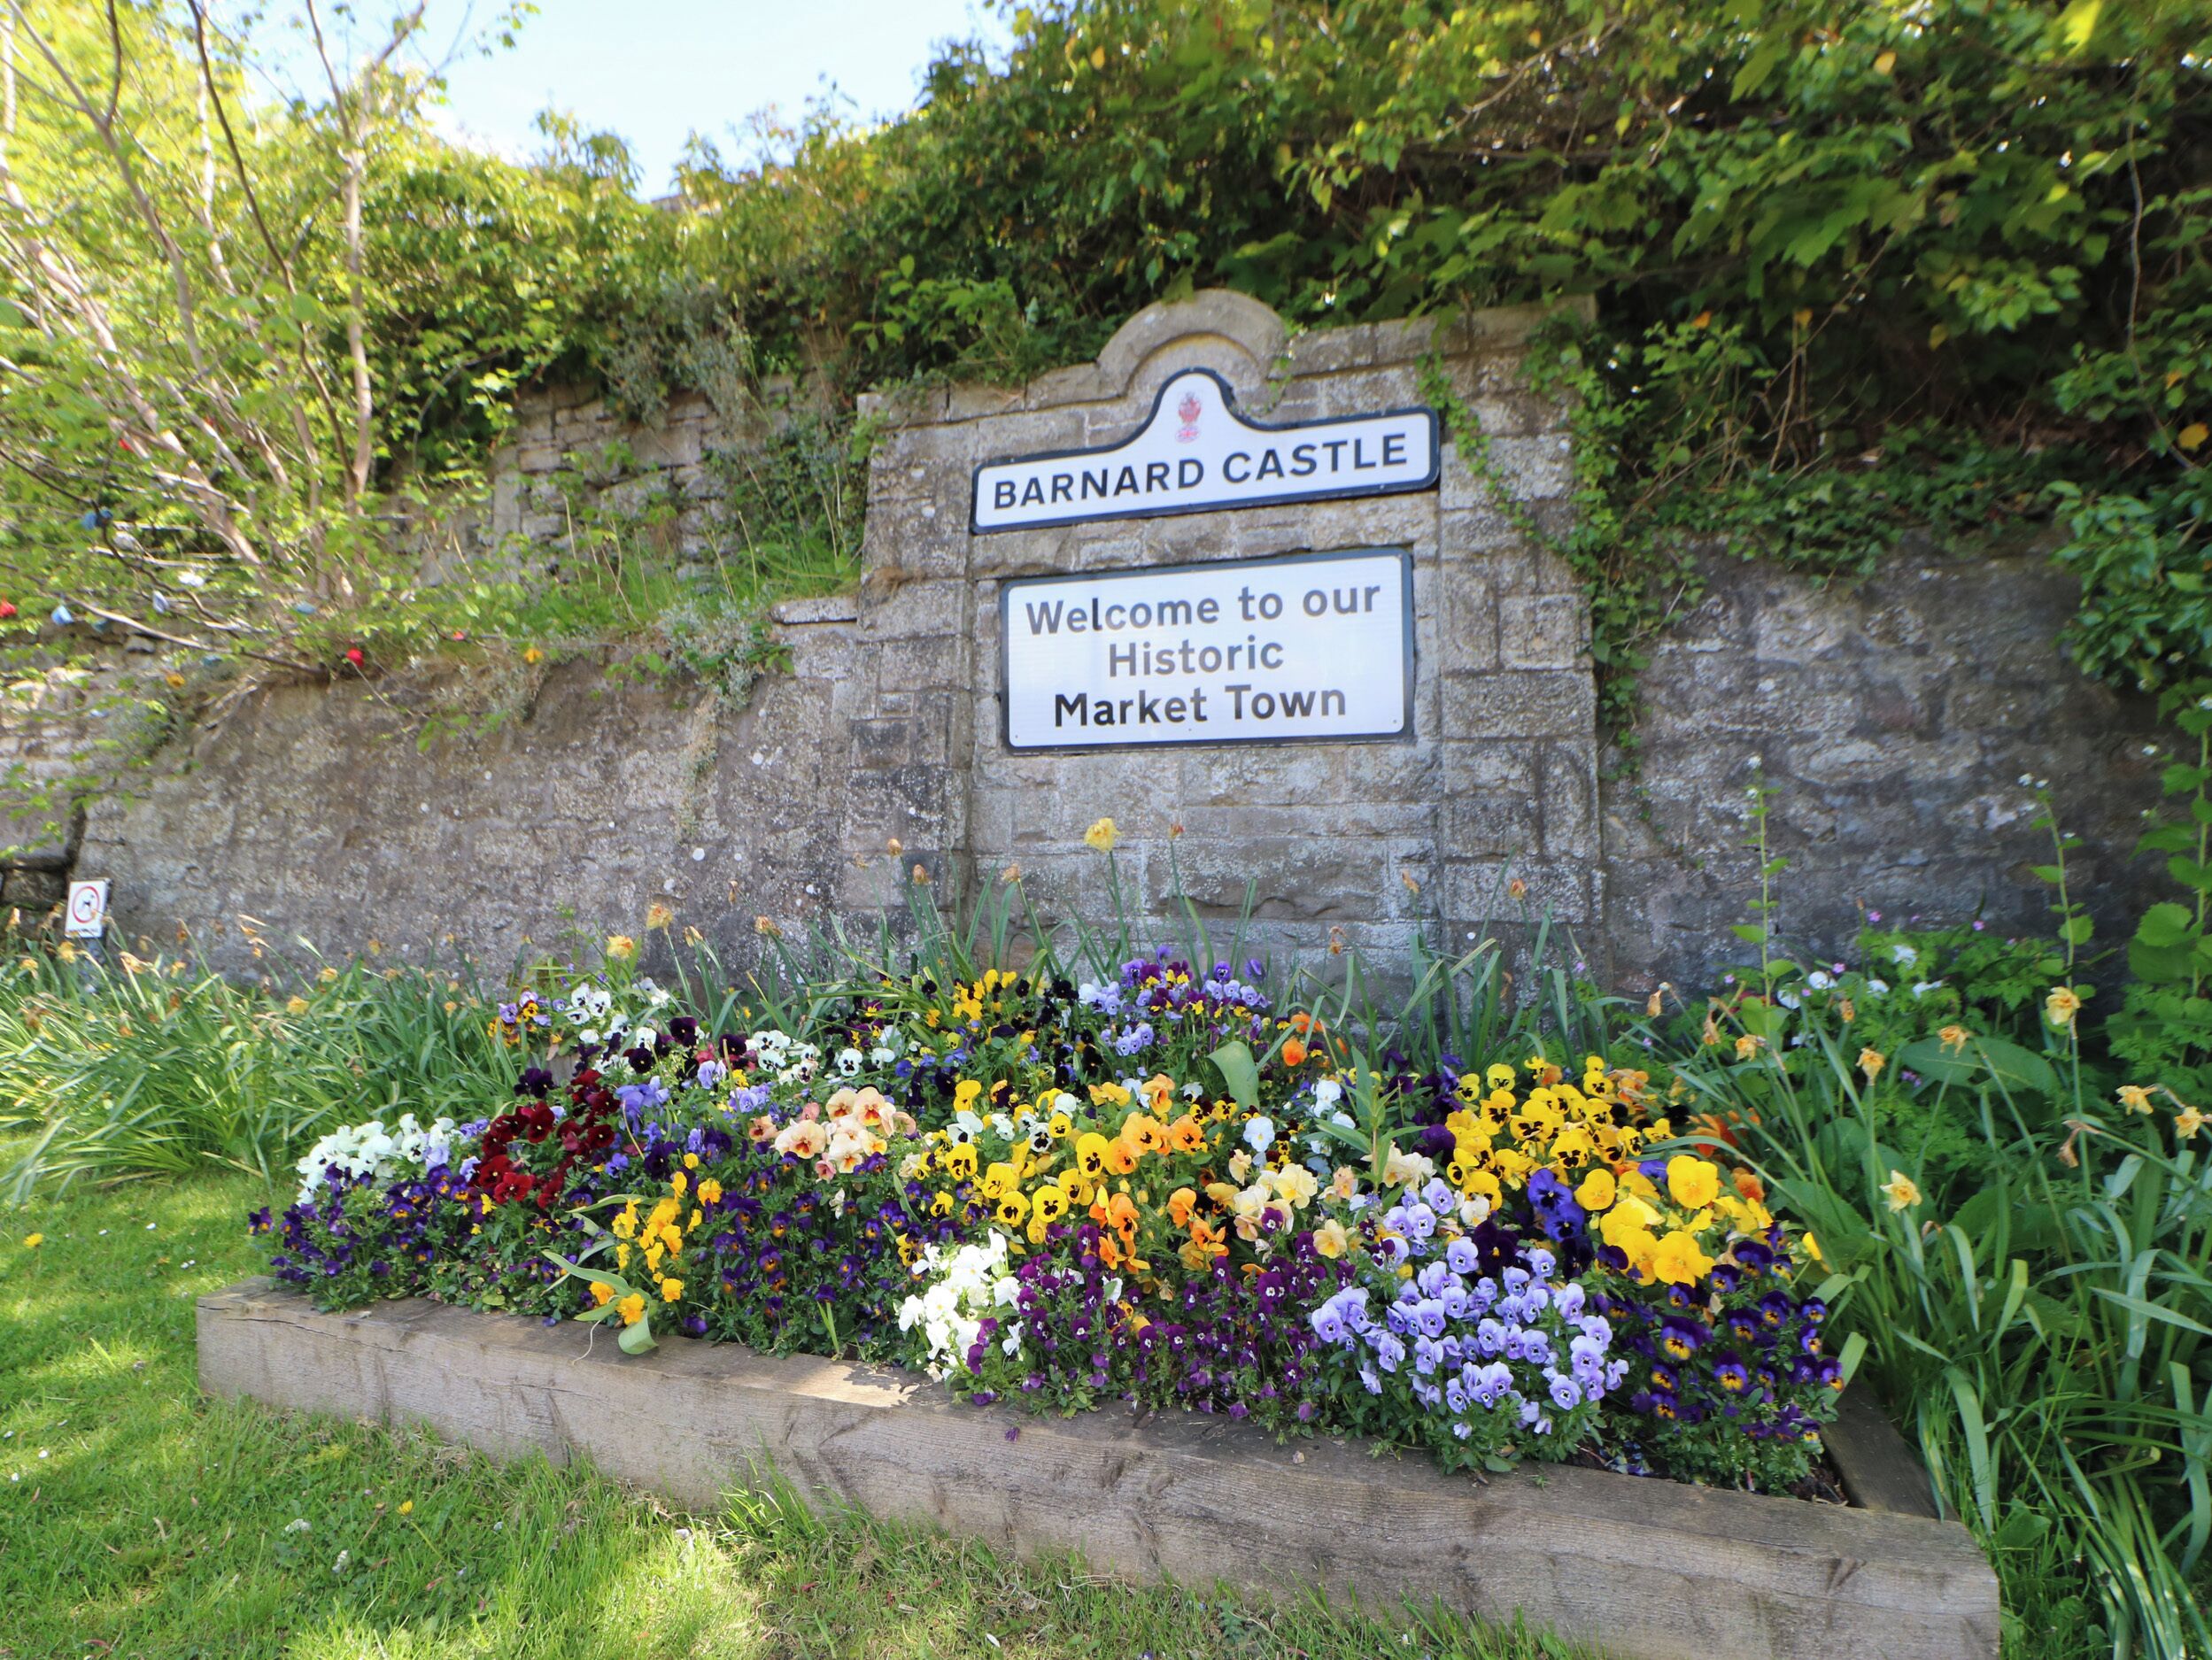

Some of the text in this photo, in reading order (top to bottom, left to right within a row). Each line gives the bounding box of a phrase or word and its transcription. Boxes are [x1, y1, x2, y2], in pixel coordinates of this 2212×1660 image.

[994, 432, 1407, 510] BARNARD CASTLE
[1025, 585, 1381, 635] Welcome to our
[1110, 635, 1283, 677] Historic
[1055, 684, 1345, 728] Market Town
